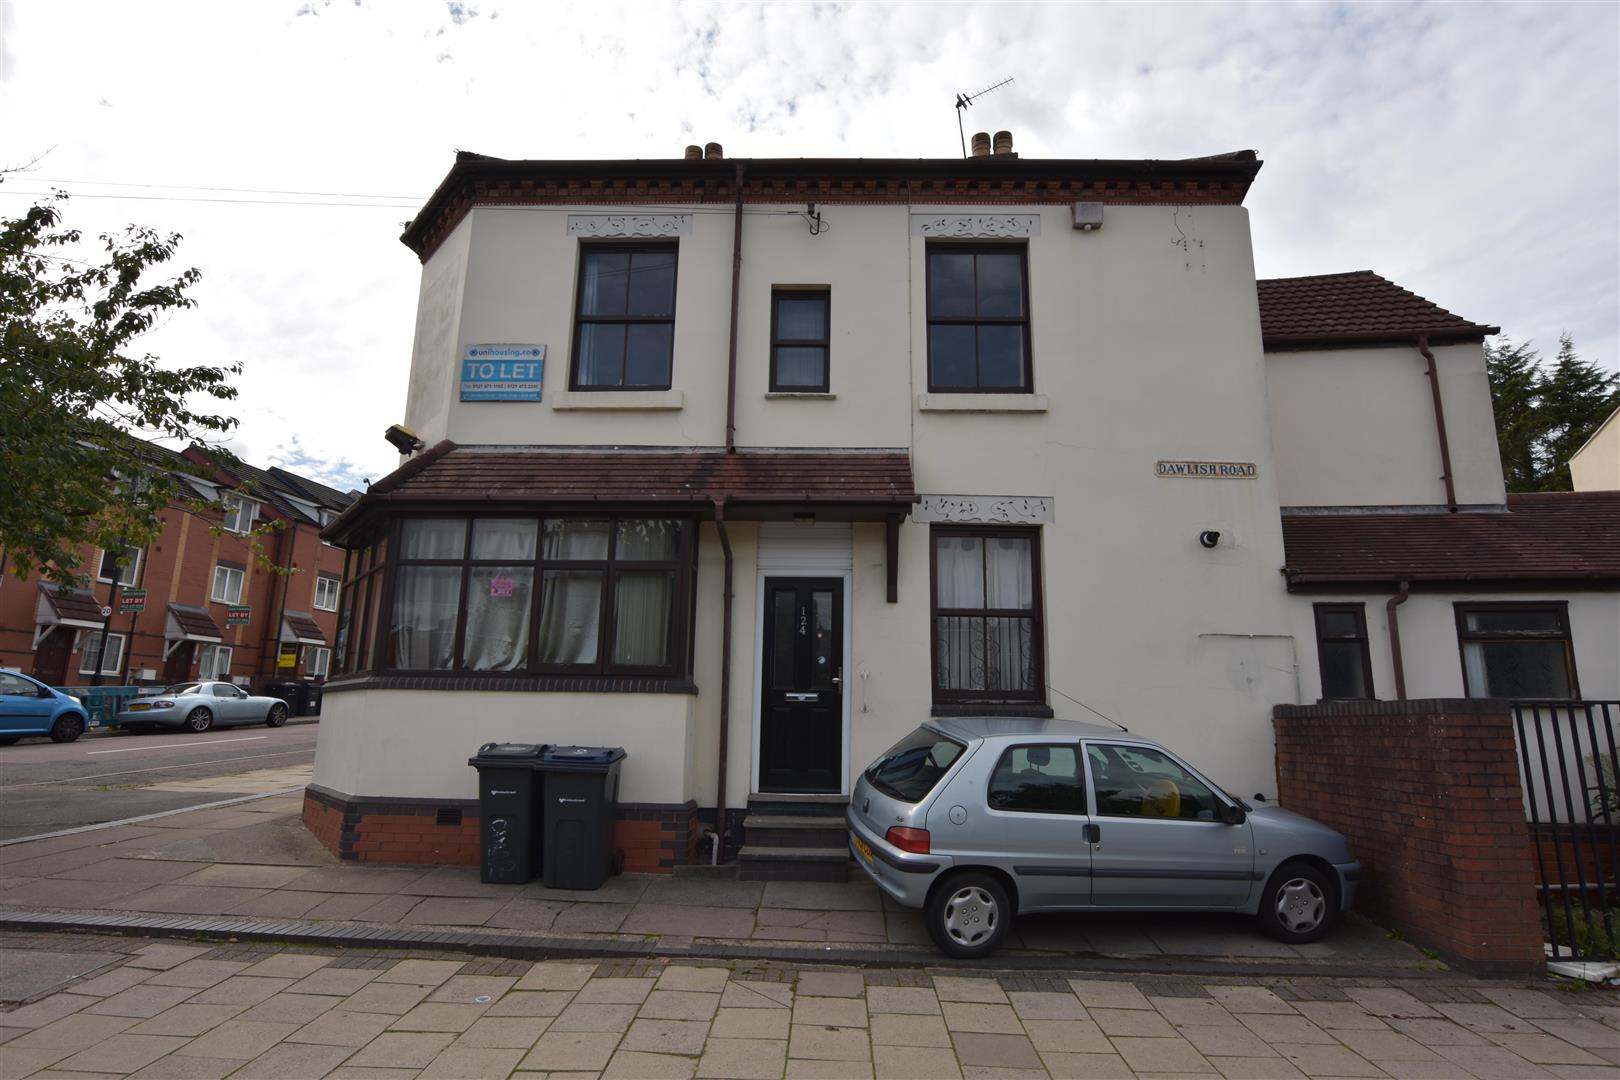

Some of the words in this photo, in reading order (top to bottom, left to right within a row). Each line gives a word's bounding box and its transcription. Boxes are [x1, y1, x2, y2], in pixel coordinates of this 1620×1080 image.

[467, 363, 495, 379] TO
[499, 363, 539, 379] LET
[1159, 463, 1217, 475] DAWLISH
[1220, 465, 1256, 476] ROAD
